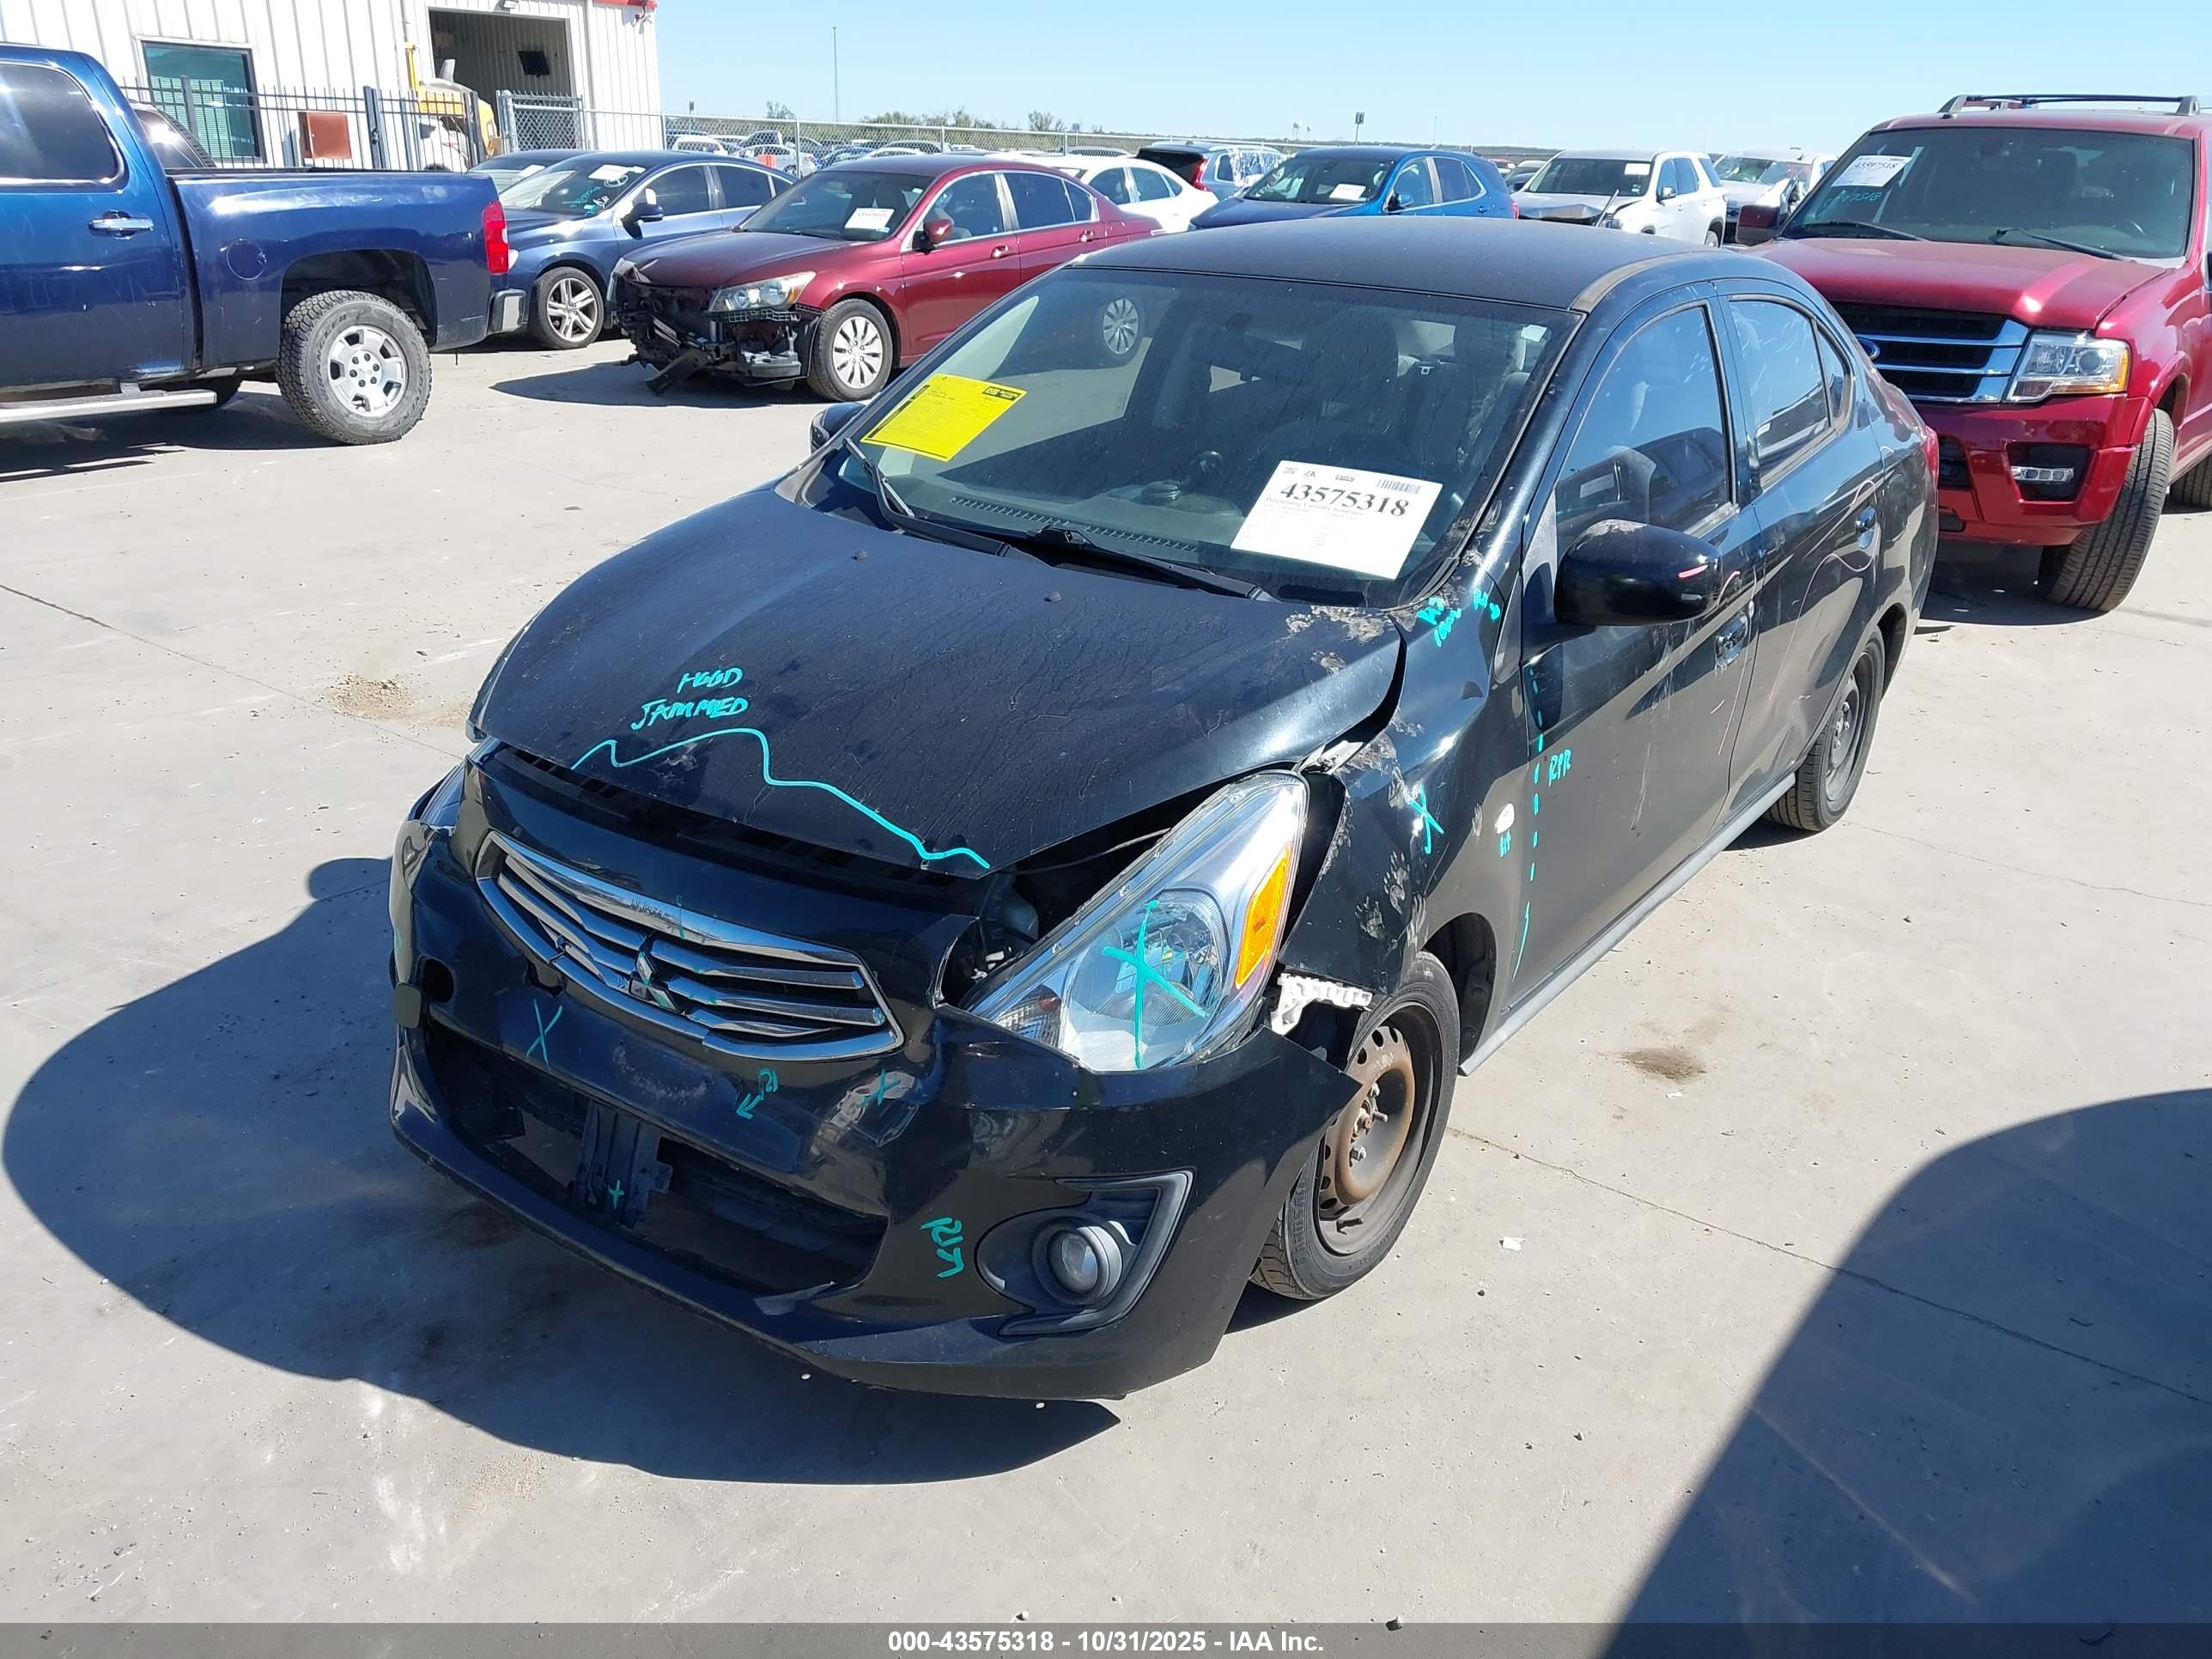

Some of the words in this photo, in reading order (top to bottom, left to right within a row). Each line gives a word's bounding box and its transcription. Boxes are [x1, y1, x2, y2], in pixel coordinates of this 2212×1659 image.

[1279, 482, 1410, 517] 43575318
[677, 666, 744, 694] HOOD
[631, 697, 748, 730] JAMMED
